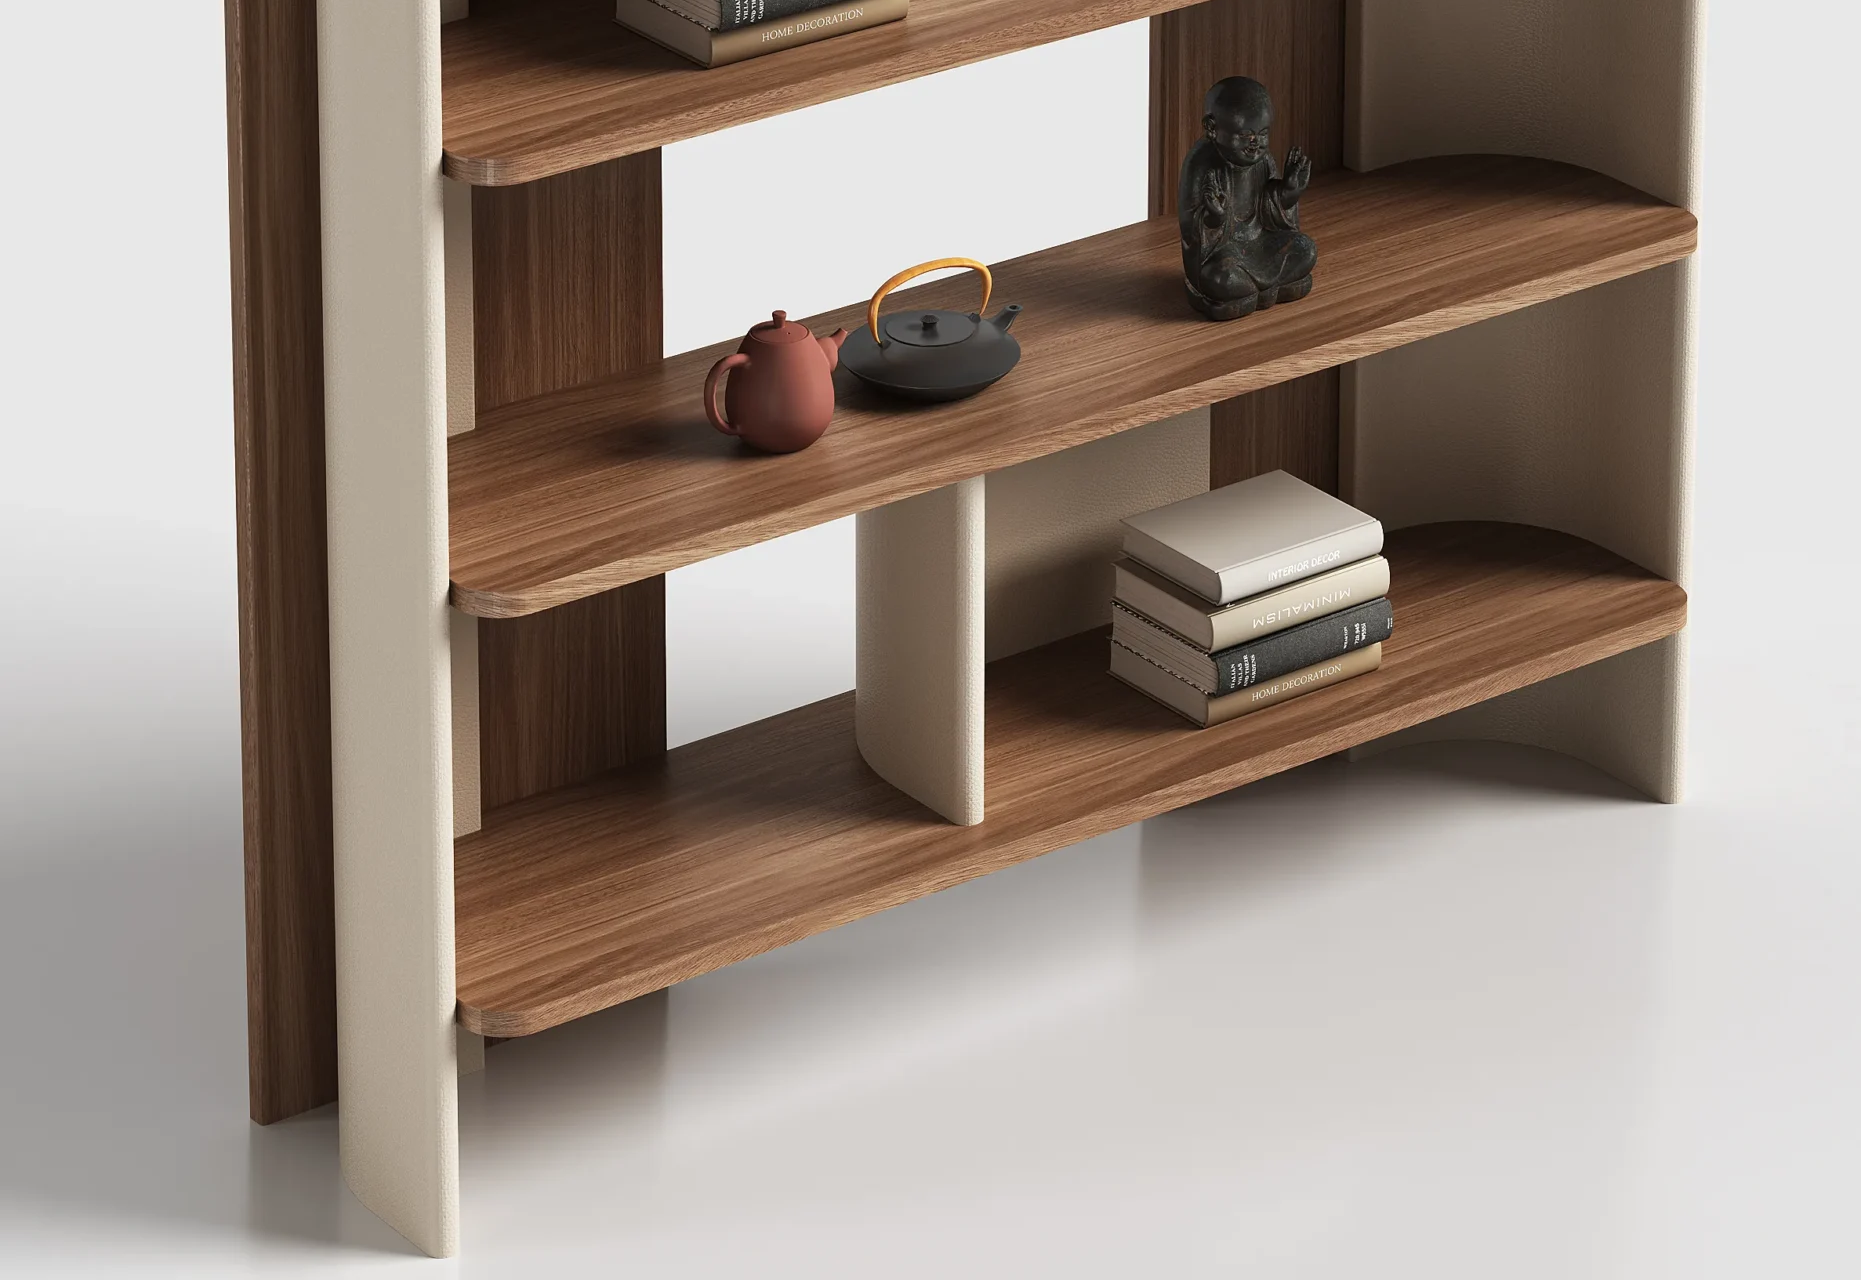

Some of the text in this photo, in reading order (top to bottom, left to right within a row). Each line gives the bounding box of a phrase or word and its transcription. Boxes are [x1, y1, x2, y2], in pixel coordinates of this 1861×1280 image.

[762, 8, 864, 42] HOME DECORATION
[1268, 550, 1340, 582] INTERIOR DECOR
[1253, 587, 1351, 629] MINIMALISM
[1252, 663, 1342, 702] HOME DECORATION
